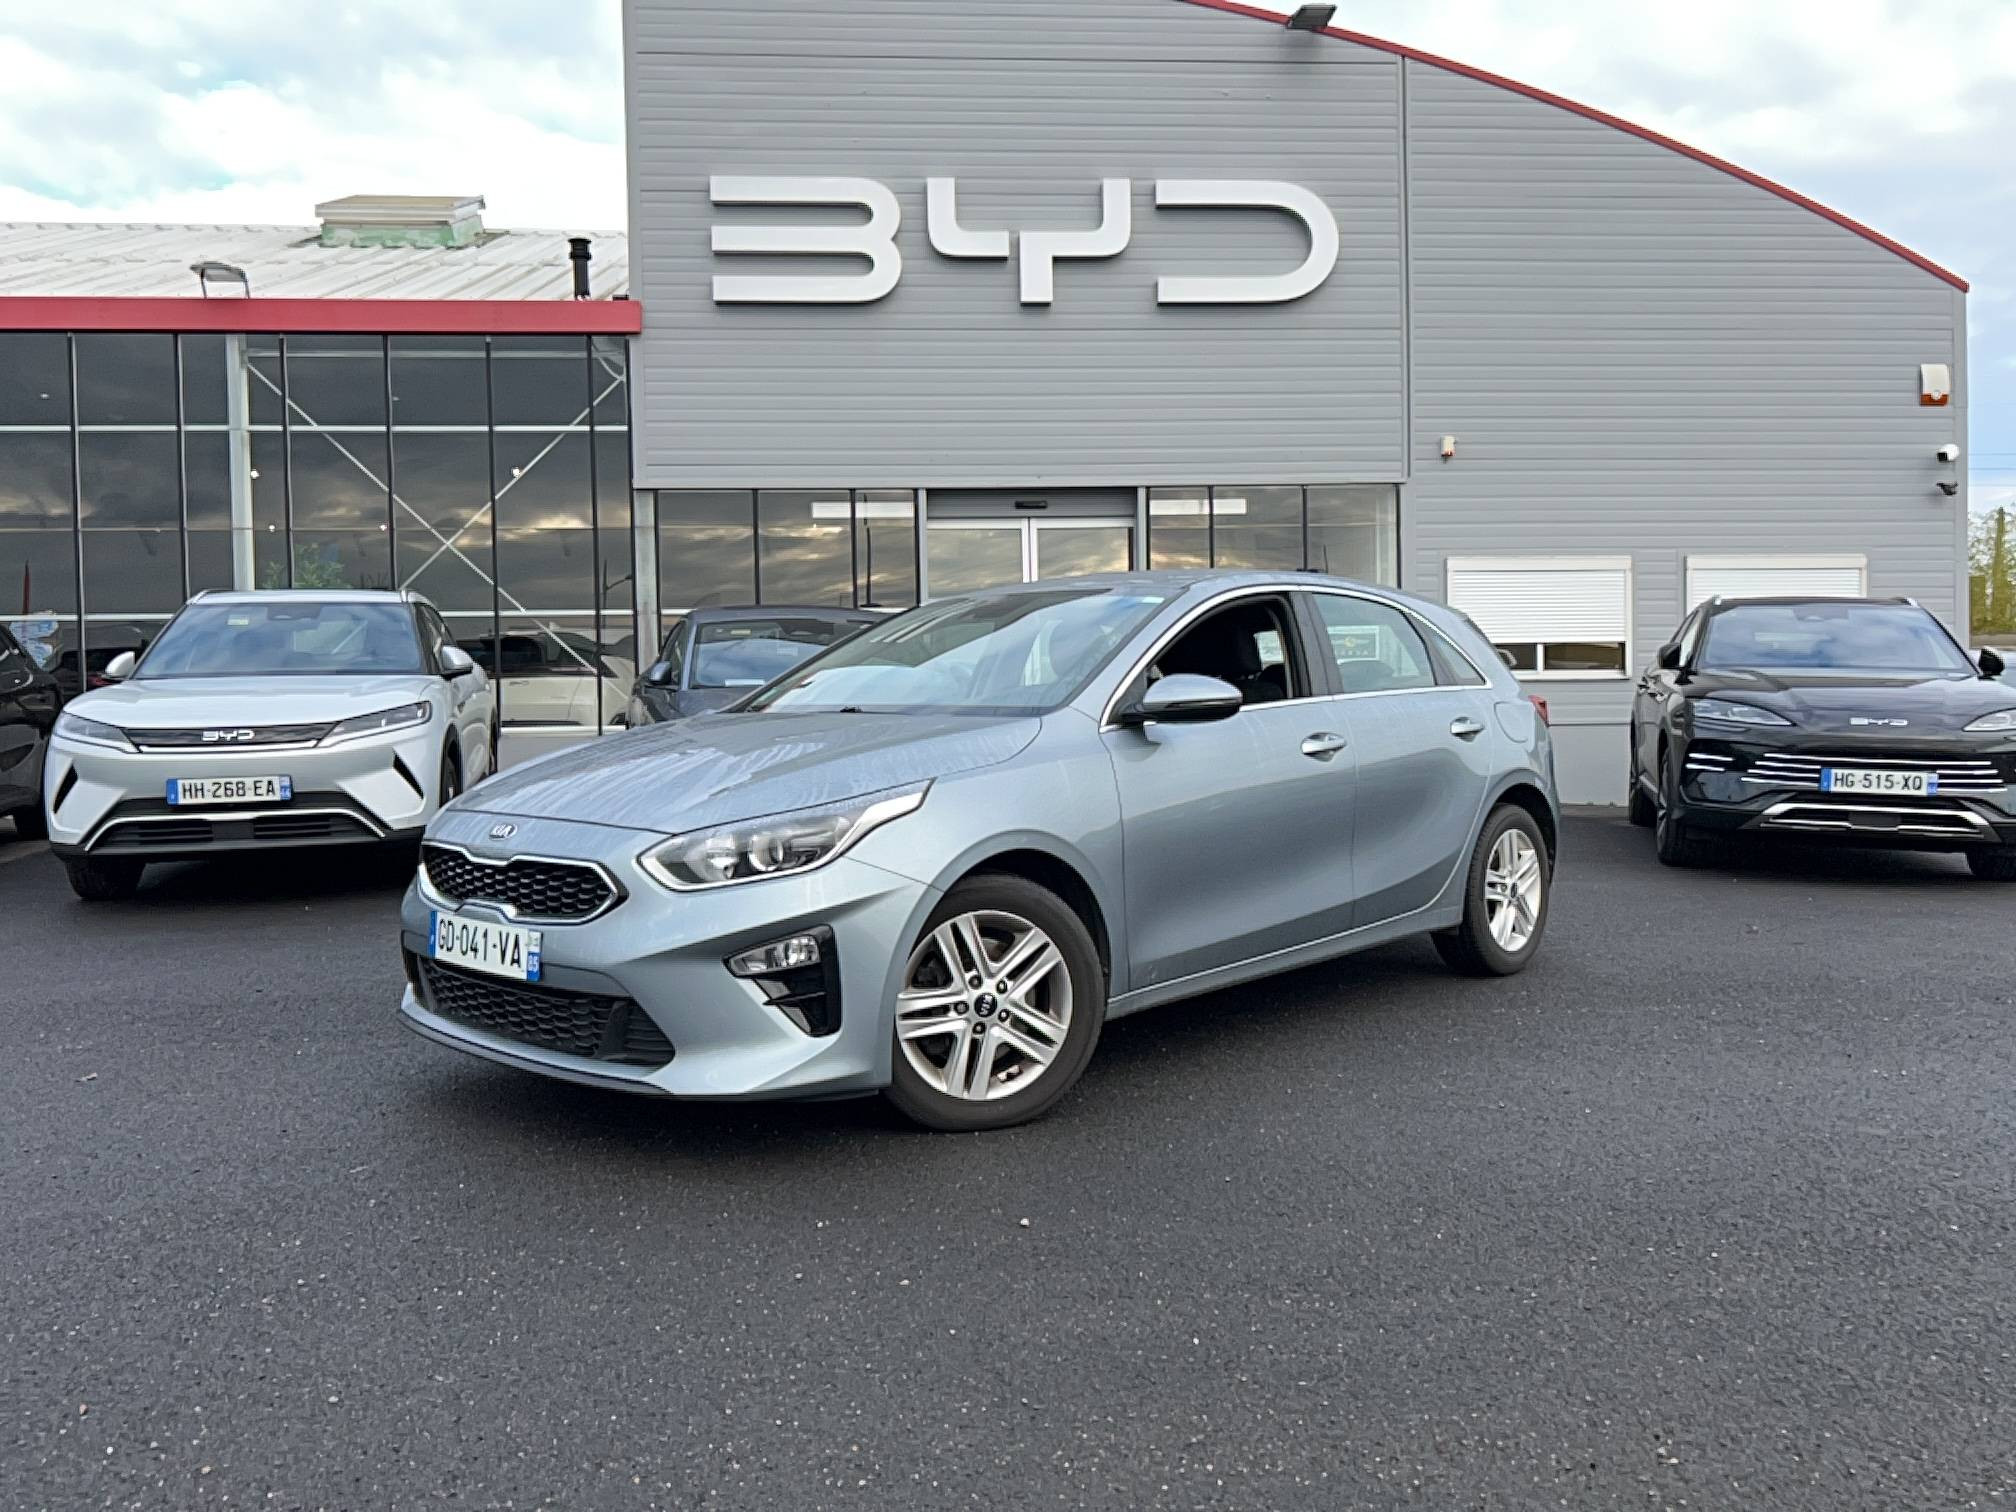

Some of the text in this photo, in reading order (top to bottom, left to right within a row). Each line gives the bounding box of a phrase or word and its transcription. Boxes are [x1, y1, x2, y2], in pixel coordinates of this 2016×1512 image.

[710, 175, 1340, 304] BYD
[202, 729, 255, 741] BYD
[182, 780, 276, 799] HH-268-EA
[438, 918, 522, 968] GD-041-VA
